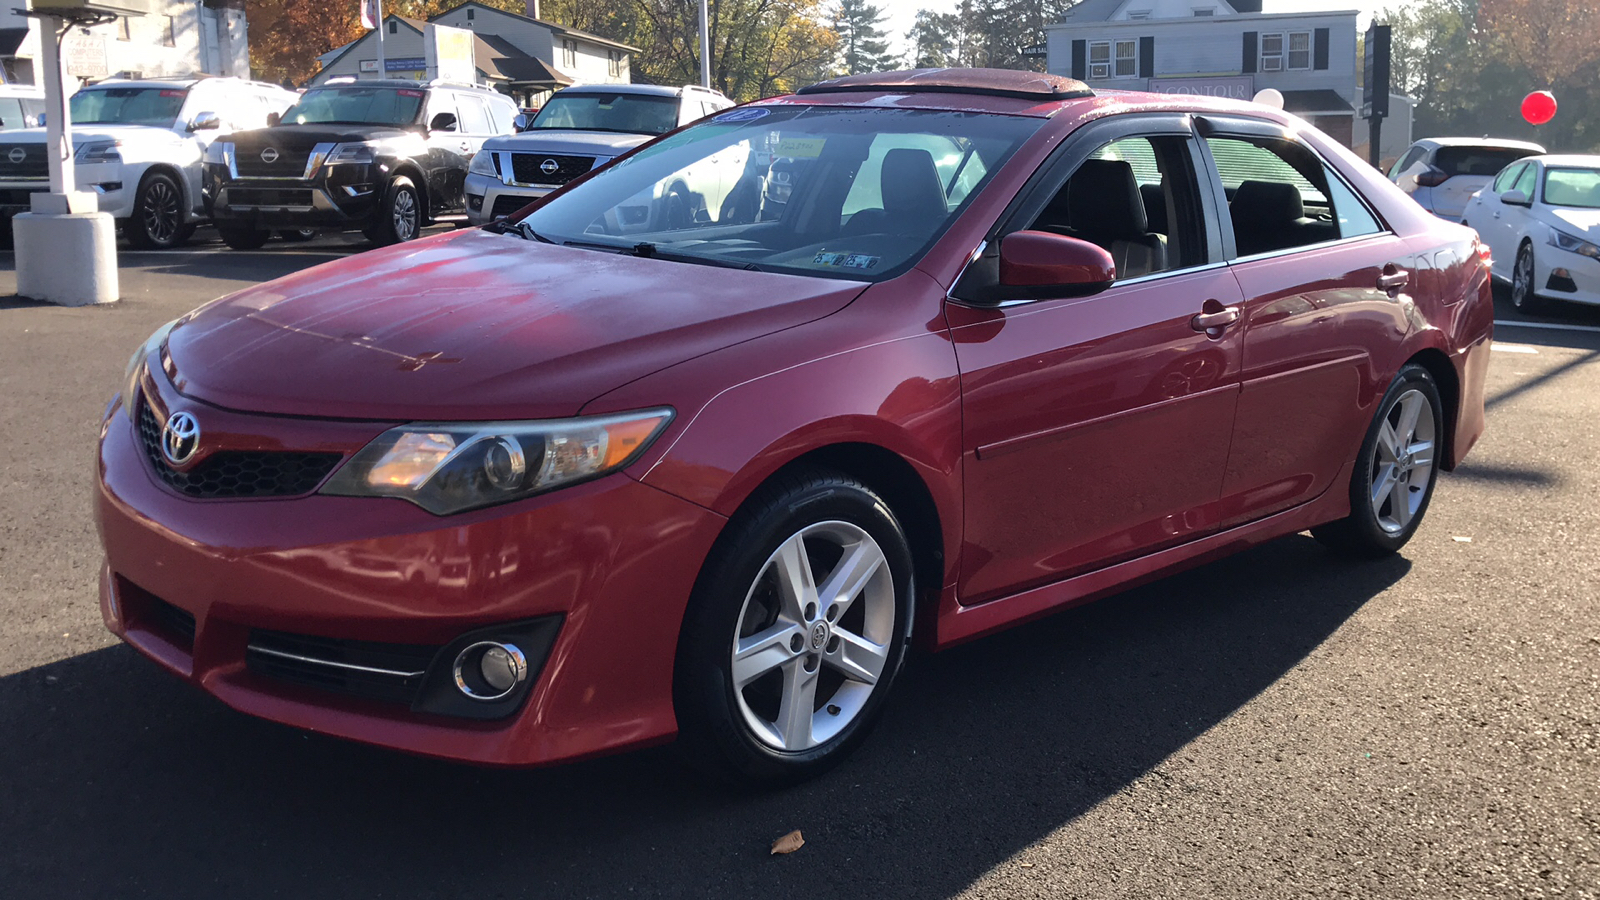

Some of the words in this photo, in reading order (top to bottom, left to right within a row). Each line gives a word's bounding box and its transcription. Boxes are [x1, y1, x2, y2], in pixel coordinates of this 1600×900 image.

[1165, 85, 1245, 98] CONTOUR
[813, 253, 826, 263] 25
[846, 255, 859, 265] 25
